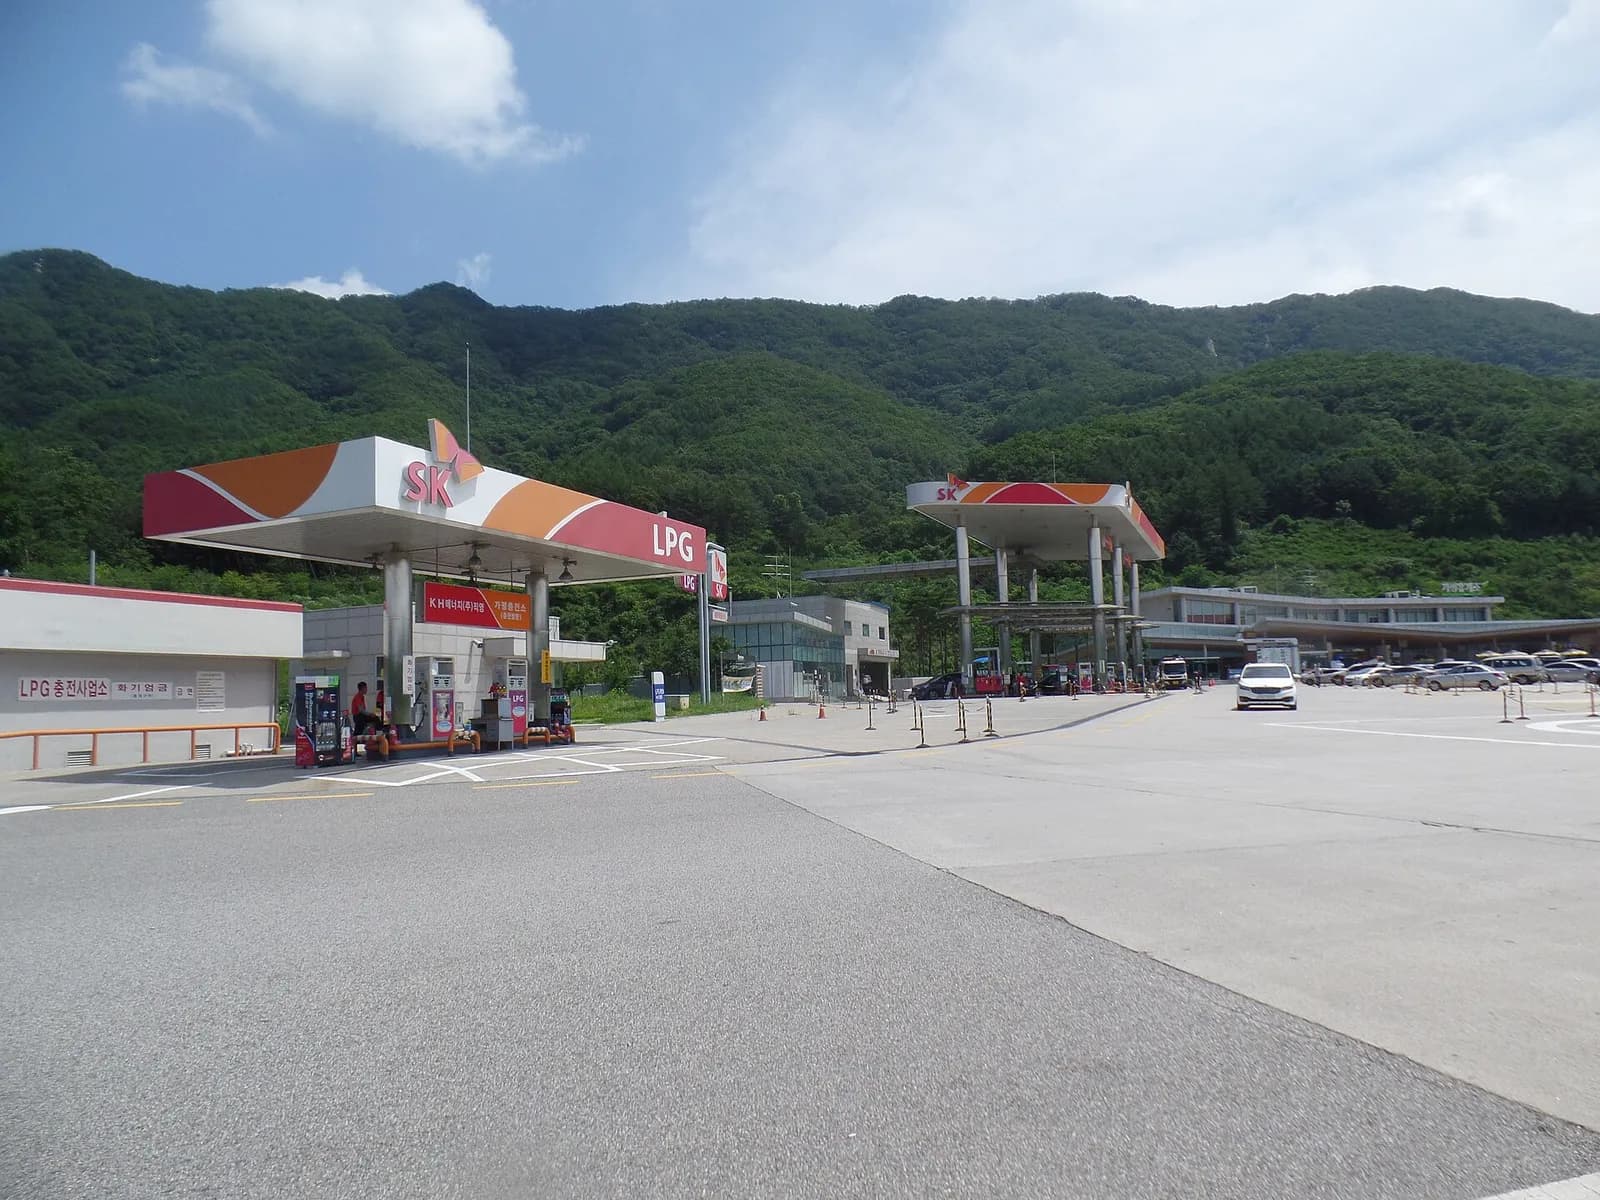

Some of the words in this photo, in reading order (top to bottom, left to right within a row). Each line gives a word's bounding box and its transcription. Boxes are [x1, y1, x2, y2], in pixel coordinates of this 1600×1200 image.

[403, 461, 453, 508] SK
[937, 488, 957, 501] SK
[652, 523, 694, 562] LPG
[683, 575, 695, 590] LPG
[715, 583, 724, 598] SK
[20, 679, 50, 697] LPG
[54, 679, 108, 698] 충전사업소
[512, 695, 524, 703] LPG
